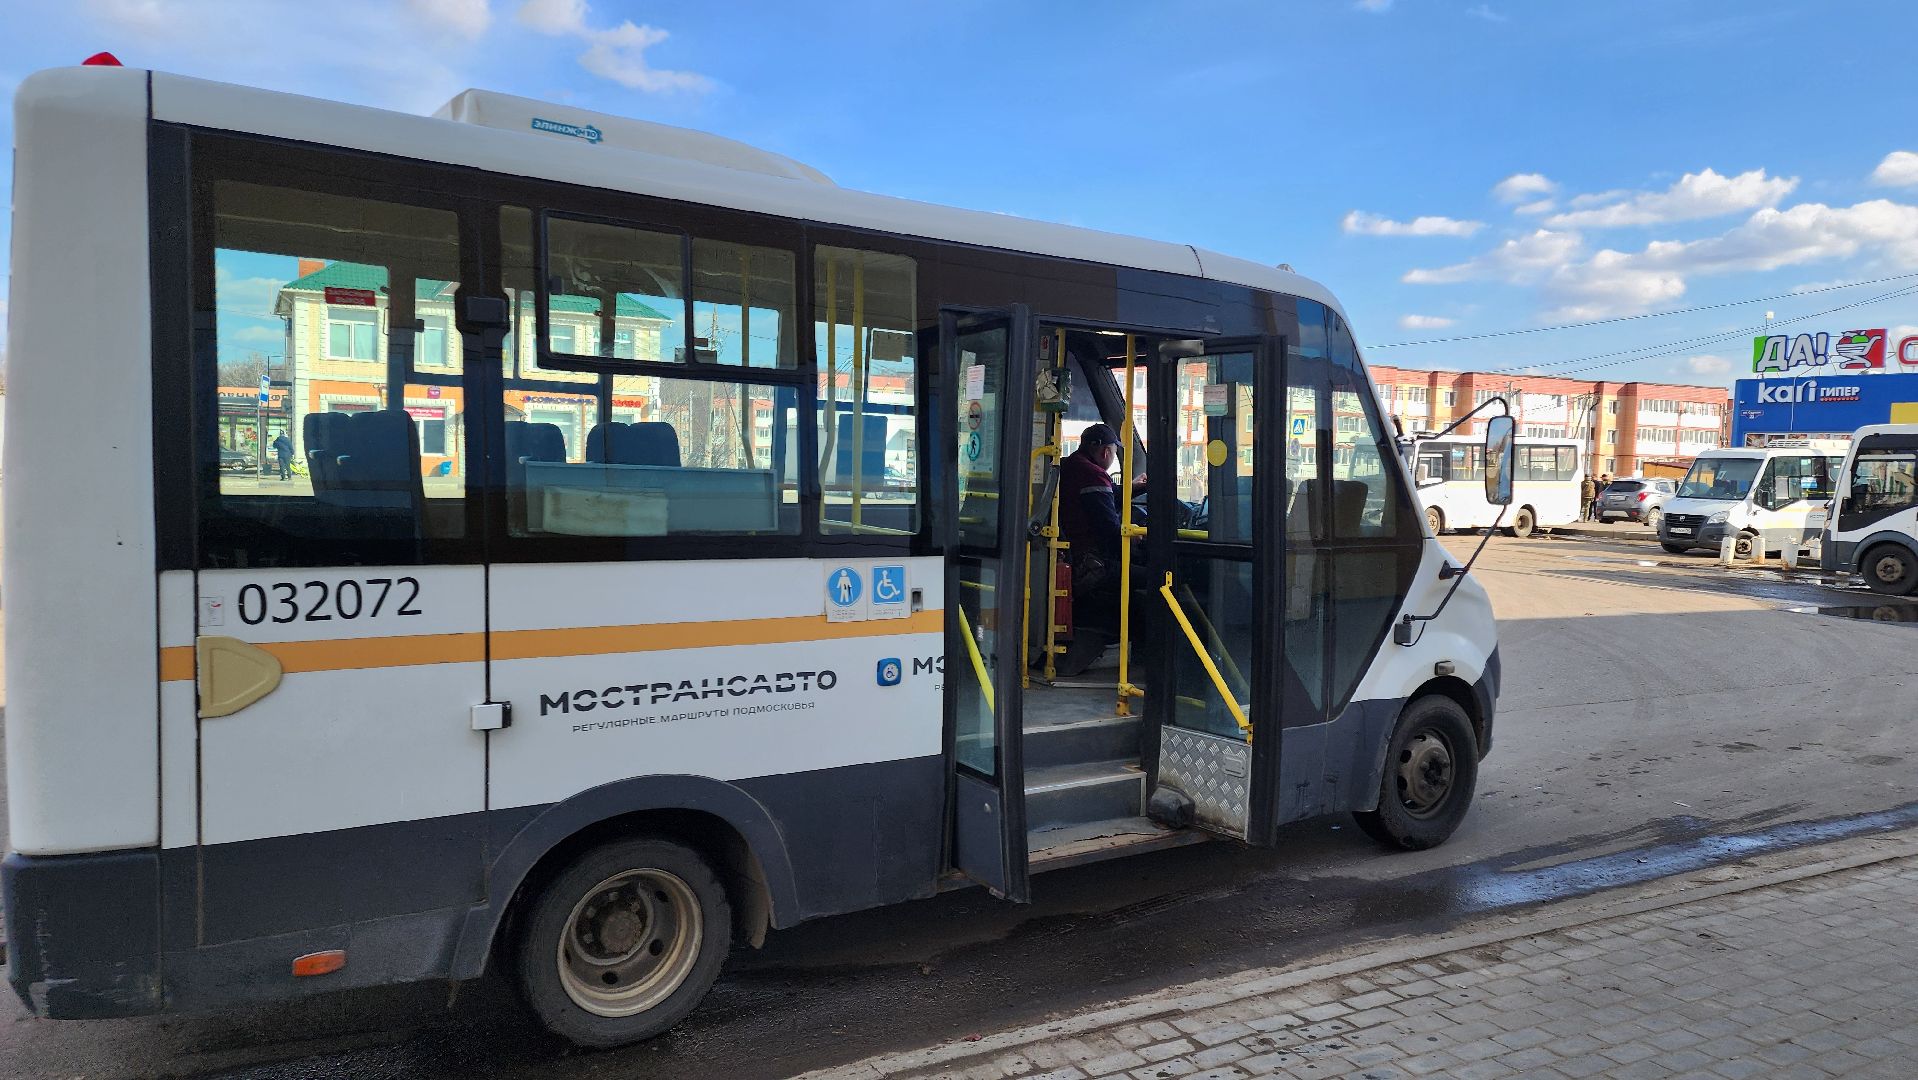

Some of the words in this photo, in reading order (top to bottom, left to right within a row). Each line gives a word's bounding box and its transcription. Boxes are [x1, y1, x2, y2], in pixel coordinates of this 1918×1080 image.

[1756, 332, 1829, 372] ДА!
[1757, 379, 1817, 404] kari
[1820, 386, 1861, 397] ГИПЕР
[238, 576, 422, 625] 032072
[540, 670, 837, 716] МОСТРАНСАВТО
[573, 716, 656, 732] РЕГУЛЯРНЫЕ
[660, 709, 729, 723] МАРШРУТЫ
[733, 702, 815, 716] ПОДМОСКОВЬЯ
